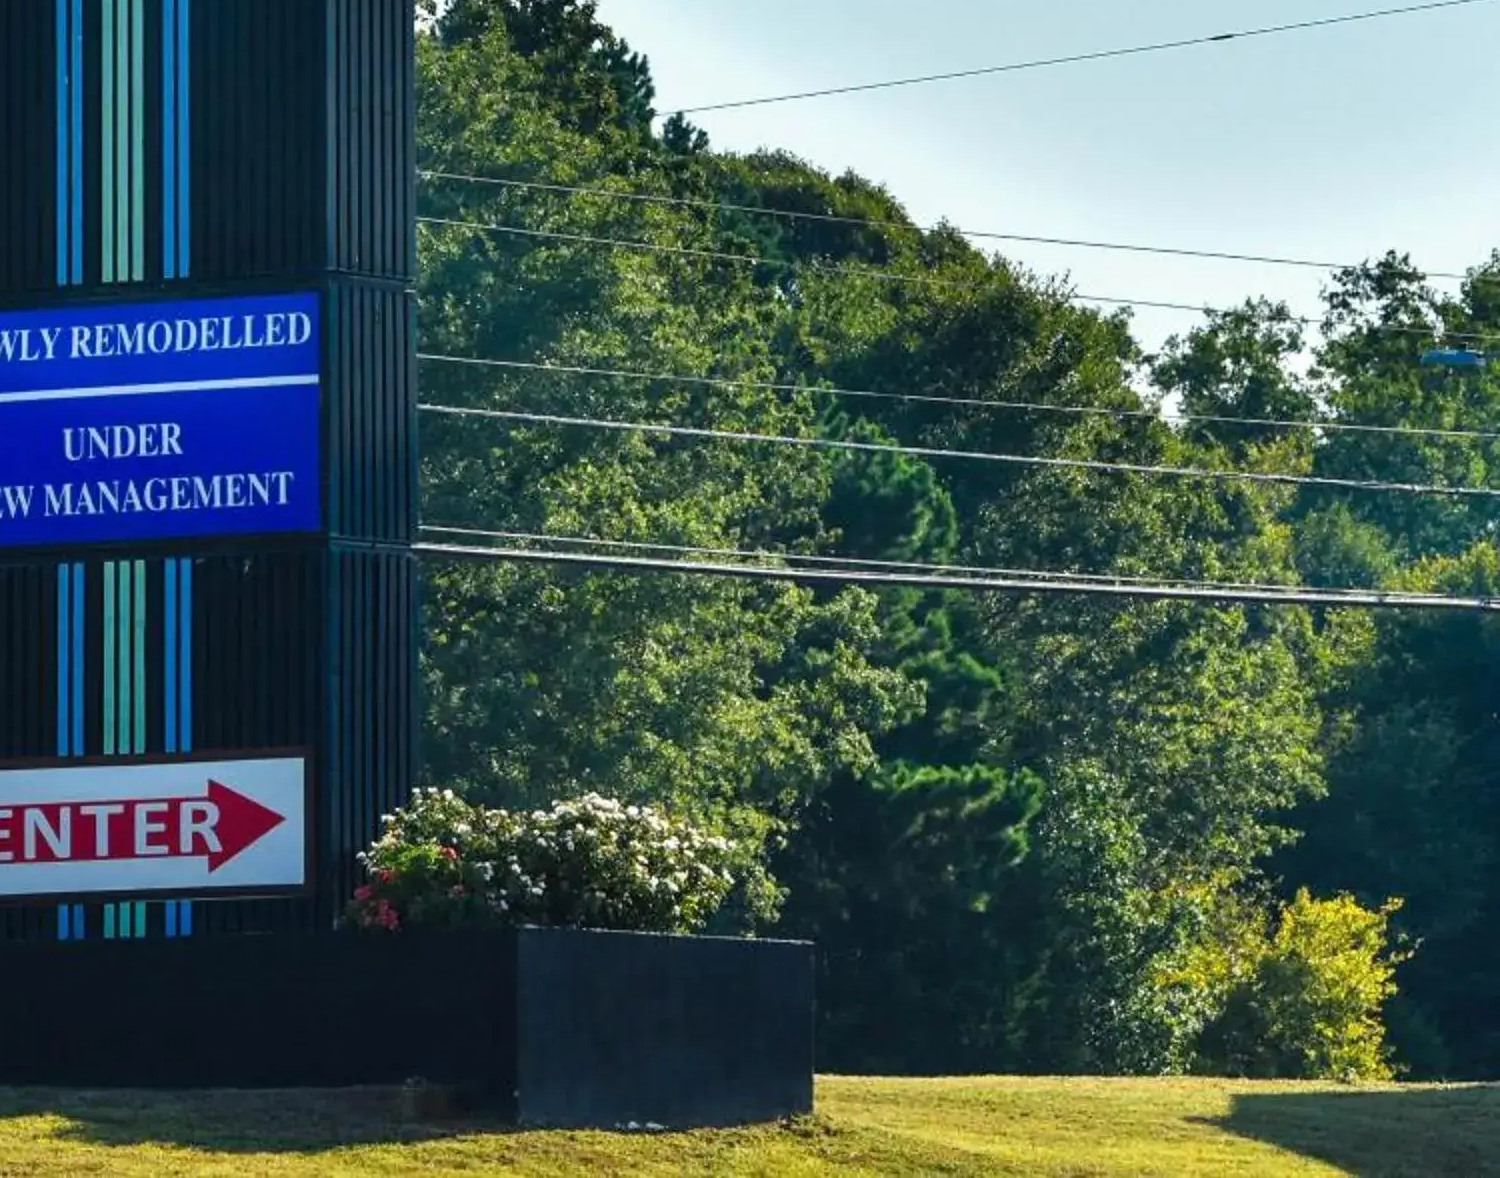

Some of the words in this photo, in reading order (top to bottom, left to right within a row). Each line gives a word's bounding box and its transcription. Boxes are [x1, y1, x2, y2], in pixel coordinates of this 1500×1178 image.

[70, 311, 311, 359] REMODELLED
[63, 422, 184, 461] UNDER
[44, 471, 295, 516] MANAGEMENT
